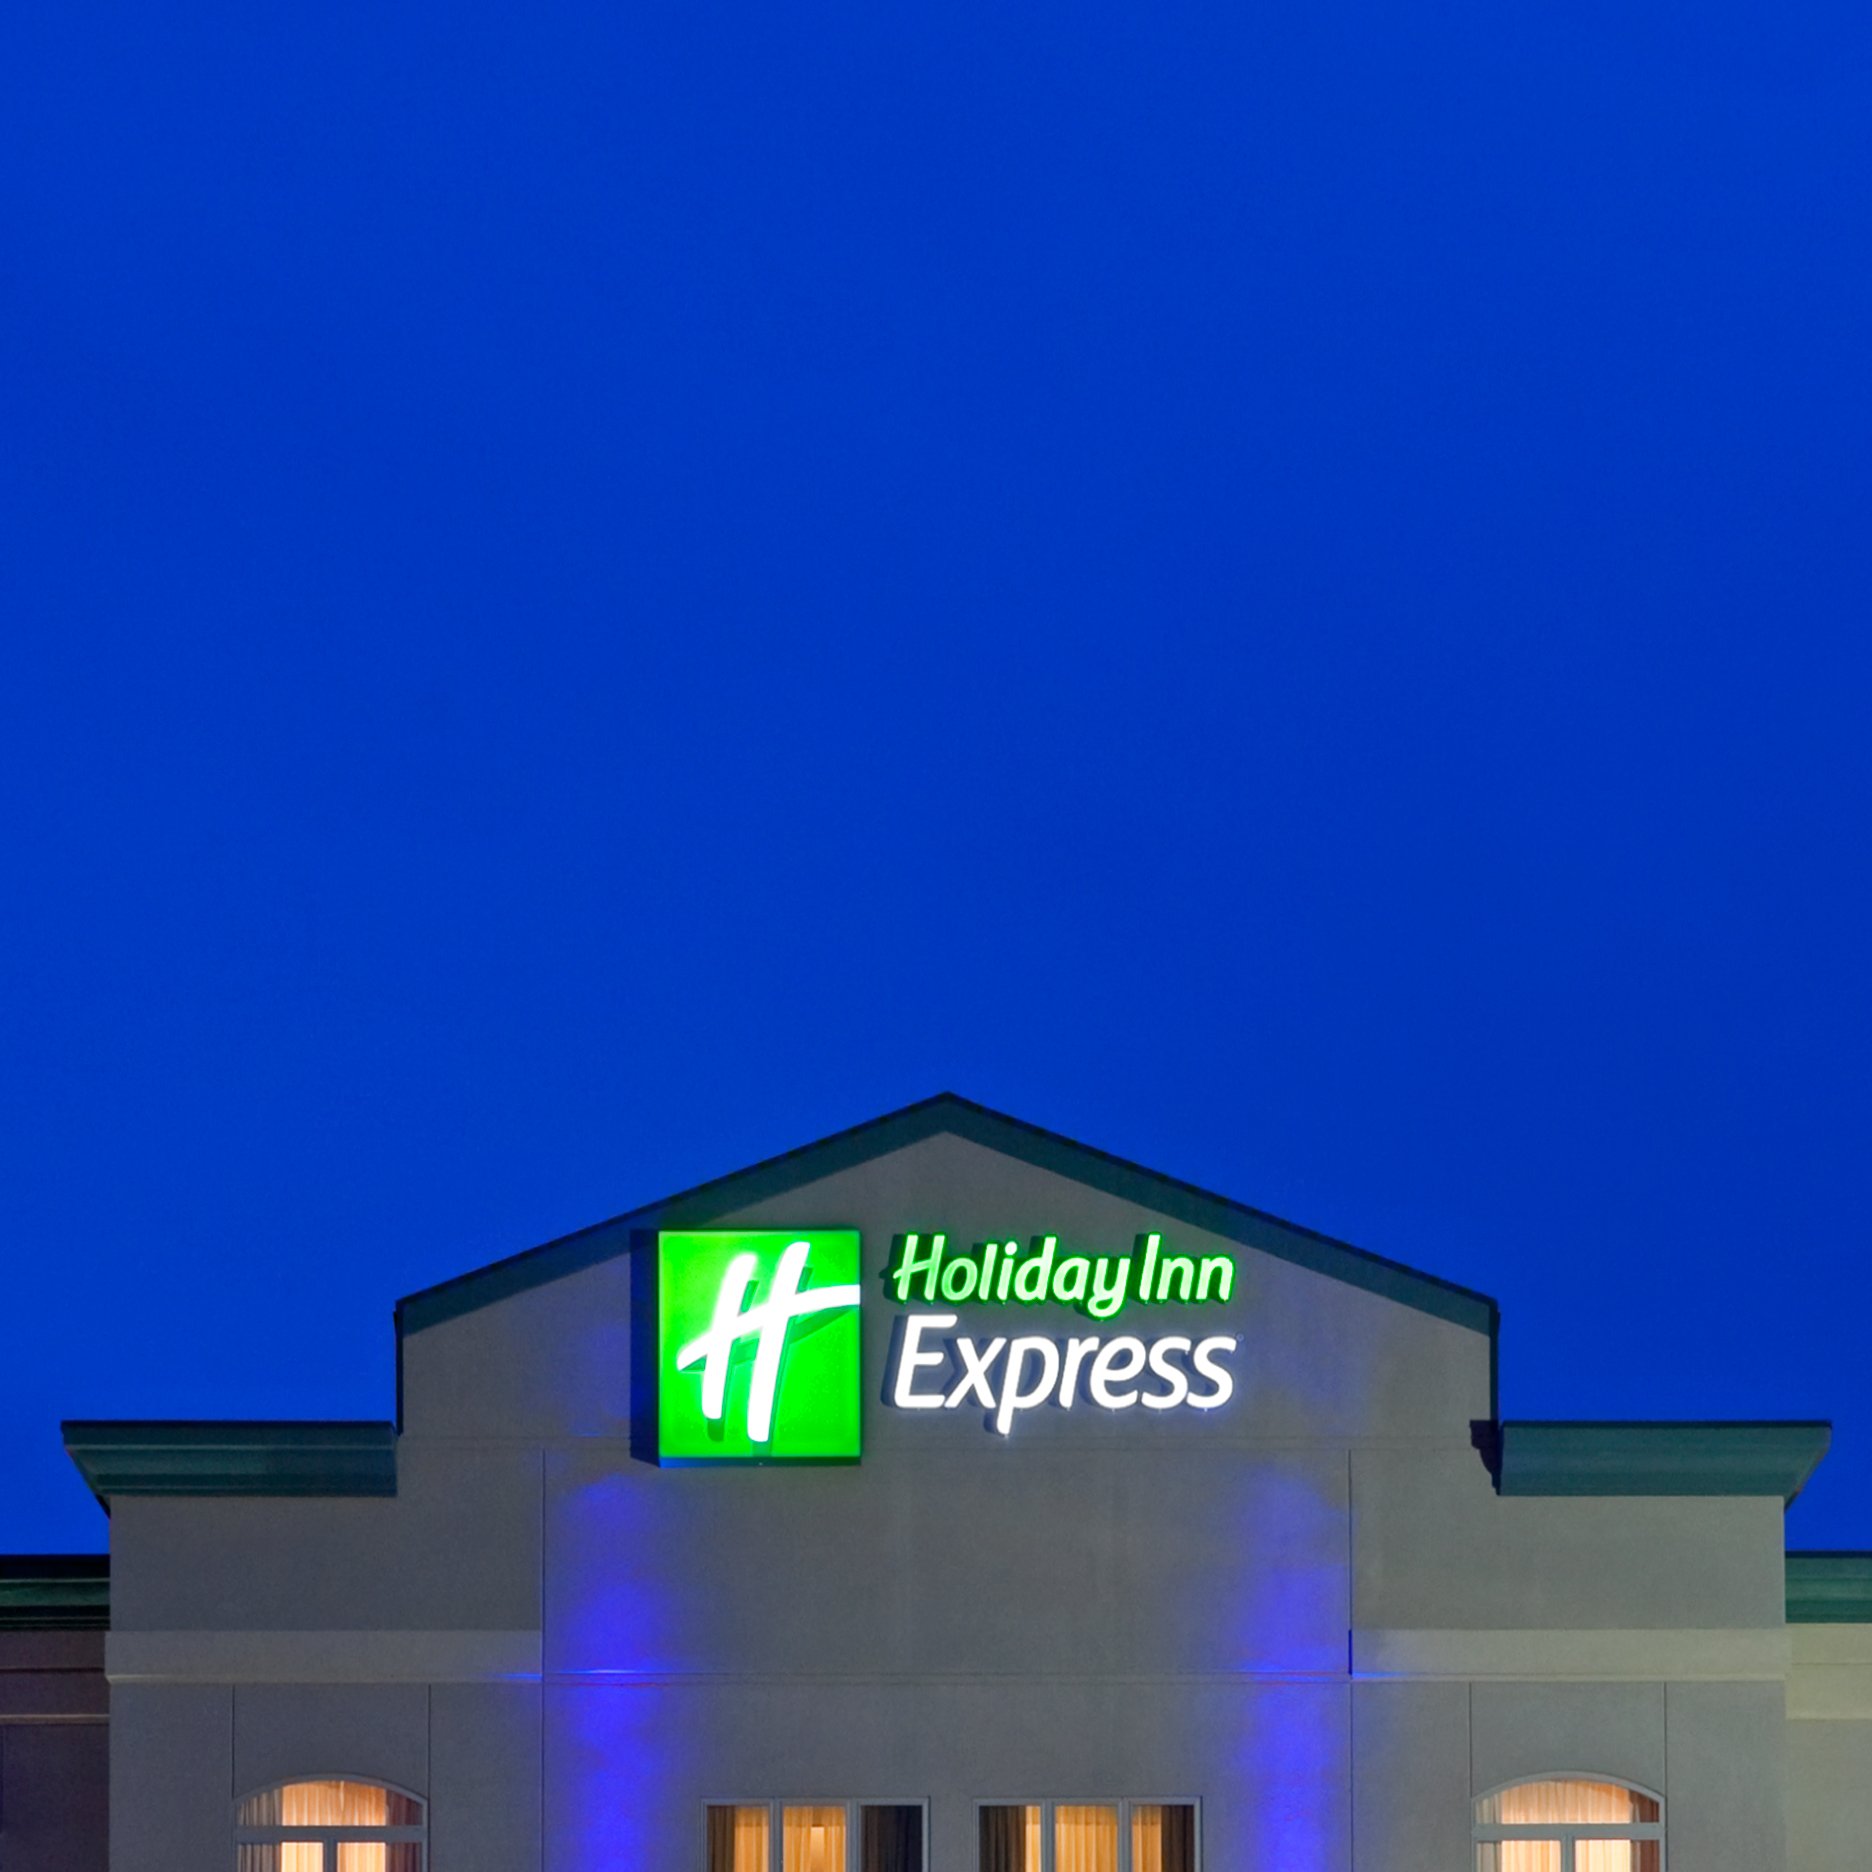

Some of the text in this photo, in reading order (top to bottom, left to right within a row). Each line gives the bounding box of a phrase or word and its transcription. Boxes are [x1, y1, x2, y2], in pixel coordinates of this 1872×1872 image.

[892, 1234, 1234, 1318] Holiday Inn
[678, 1243, 859, 1441] H
[894, 1315, 1236, 1434] Express
